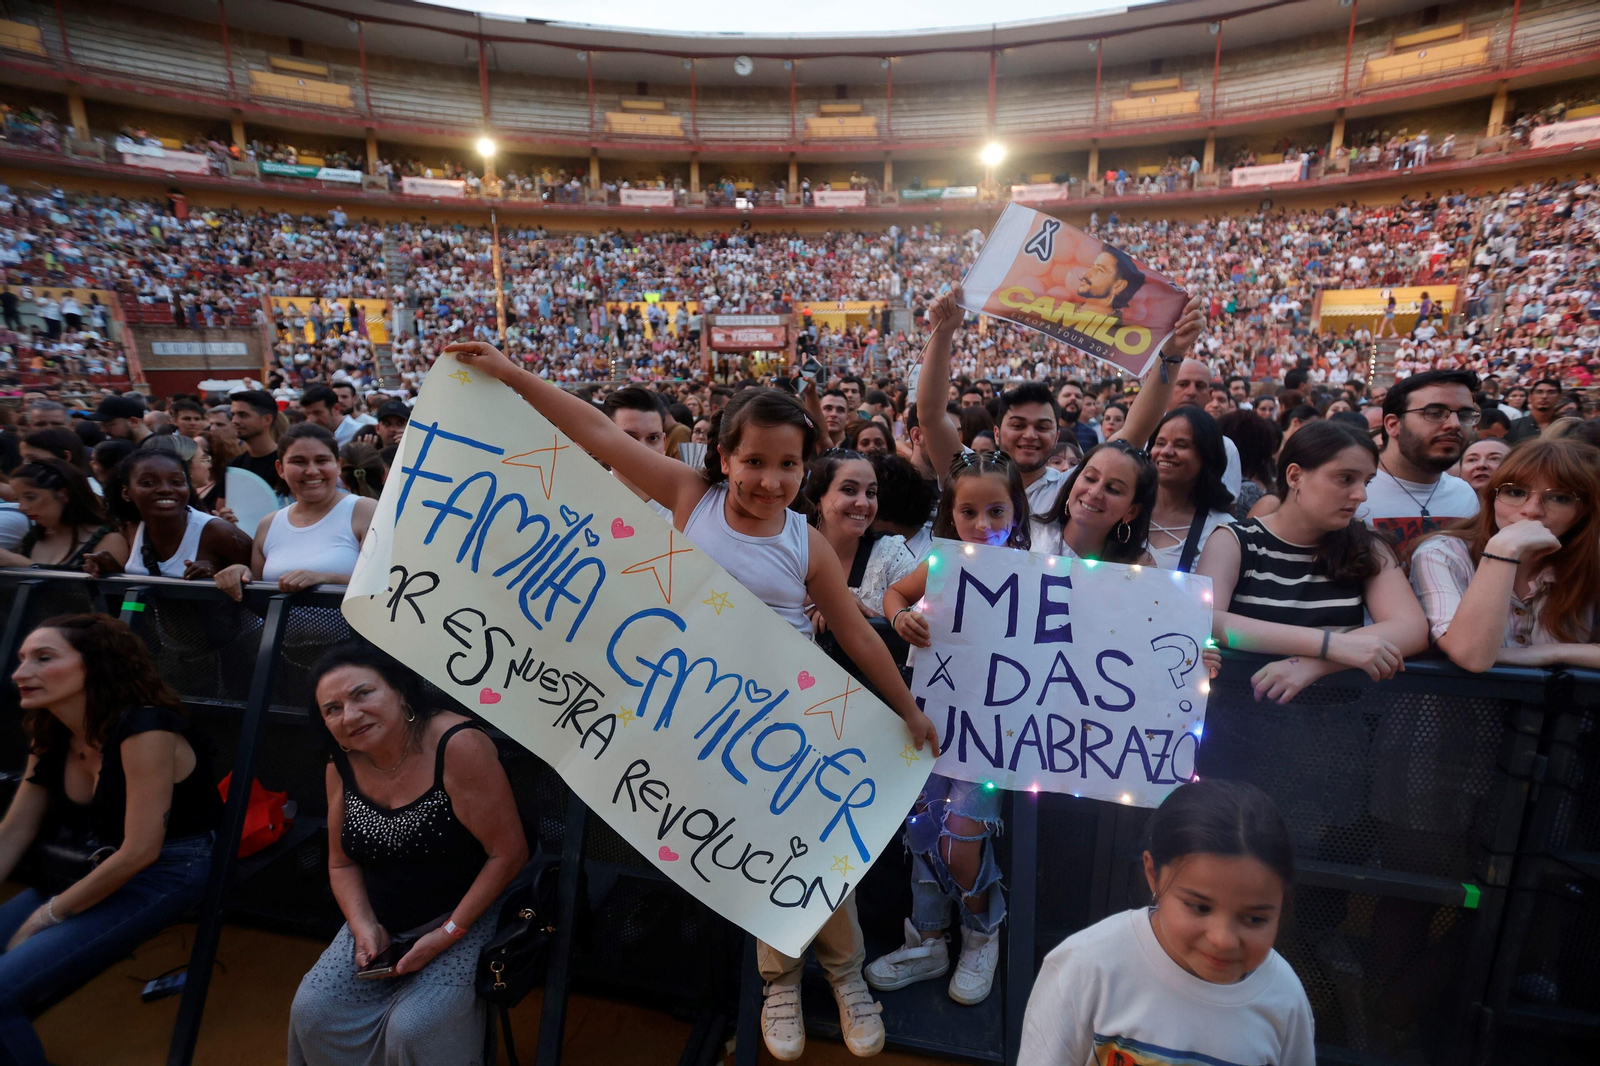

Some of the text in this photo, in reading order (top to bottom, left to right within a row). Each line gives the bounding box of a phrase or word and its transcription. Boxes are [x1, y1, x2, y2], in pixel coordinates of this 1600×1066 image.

[999, 285, 1152, 356] CAMILO
[1010, 311, 1116, 359] EUROPA TOUR 2024
[951, 566, 1074, 645] ME
[442, 607, 516, 687] ES
[503, 645, 618, 761] NUESTRA
[983, 650, 1137, 713] DAS
